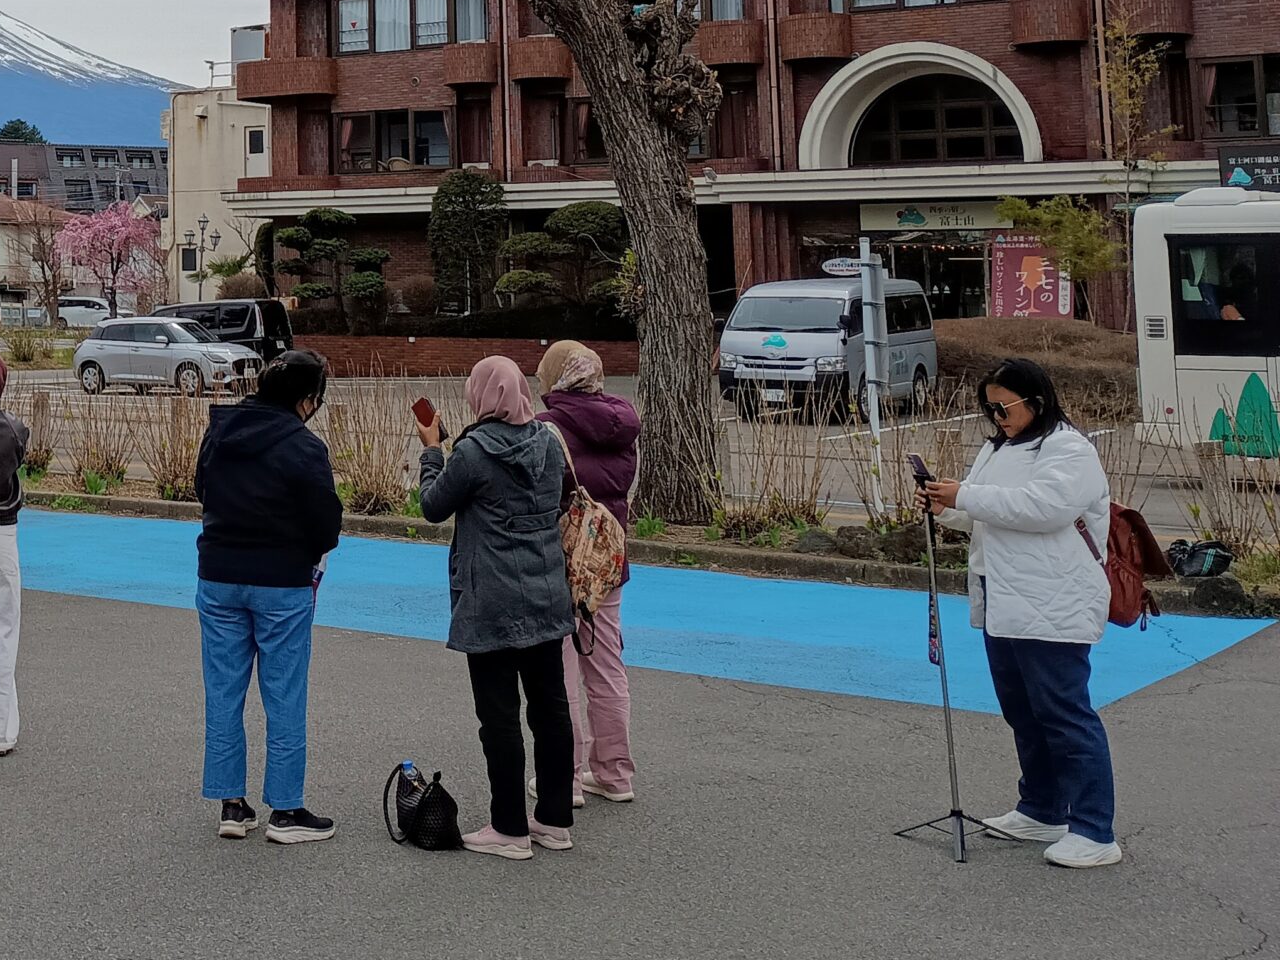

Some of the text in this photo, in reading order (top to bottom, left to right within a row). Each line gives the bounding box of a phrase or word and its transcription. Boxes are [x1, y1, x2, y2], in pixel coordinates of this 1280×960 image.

[939, 215, 974, 226] 富士山
[1036, 257, 1054, 303] 三七の
